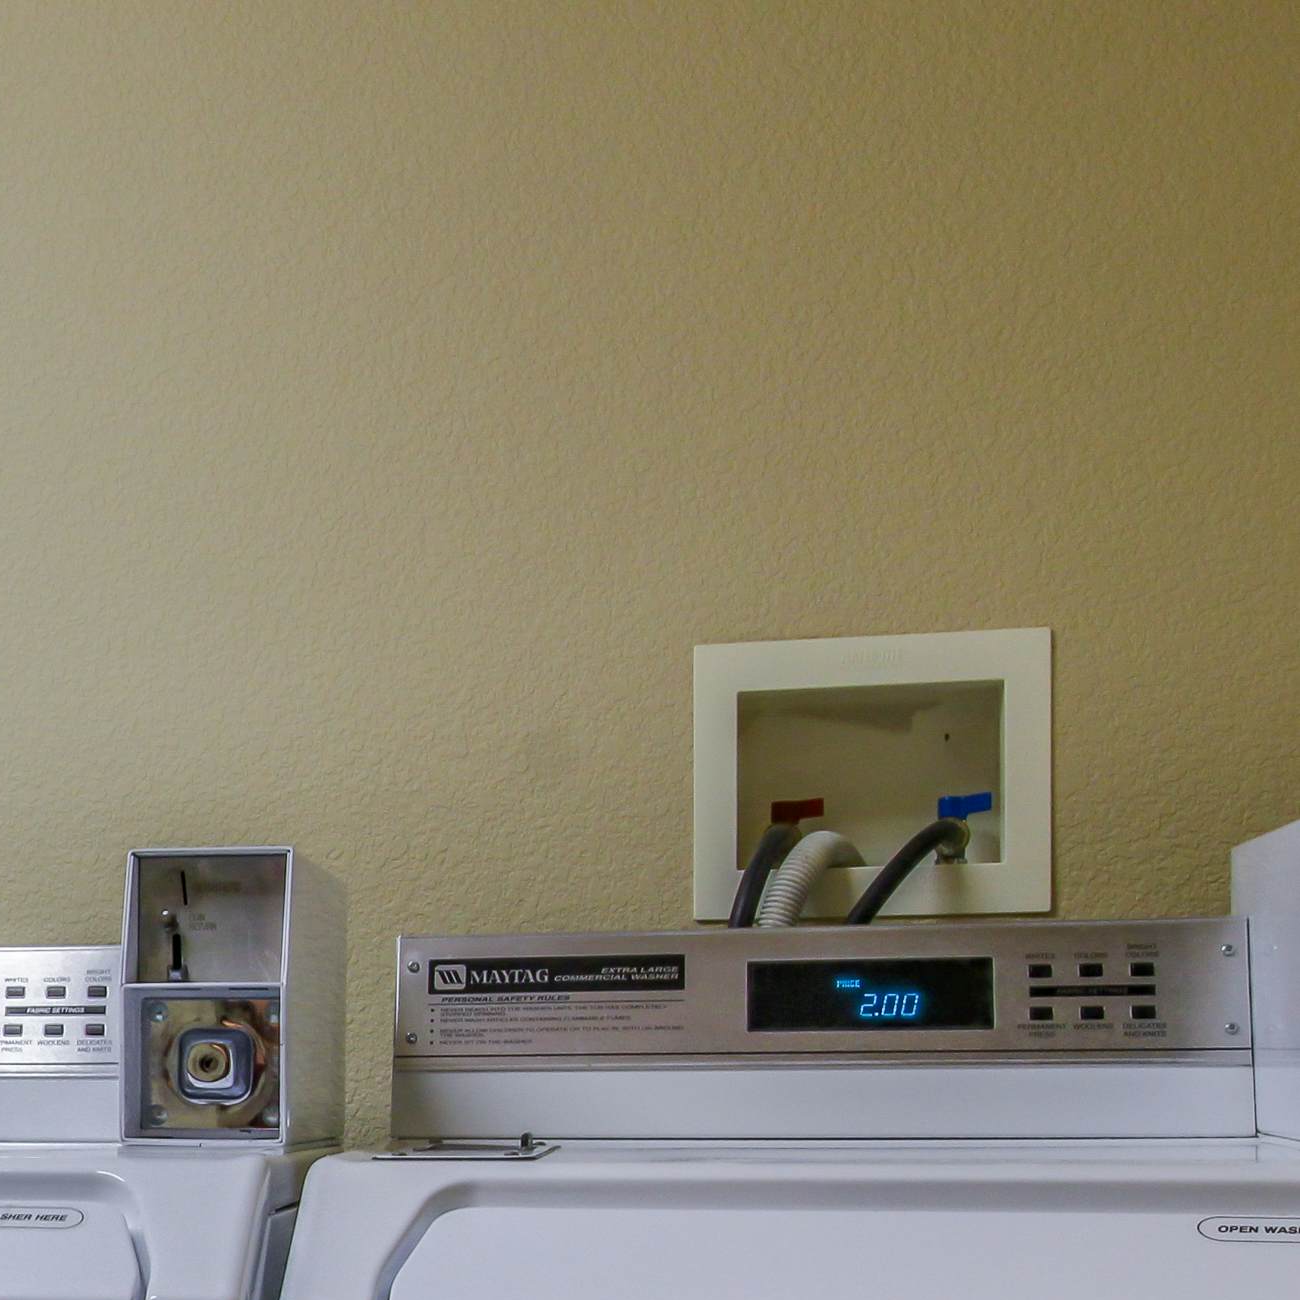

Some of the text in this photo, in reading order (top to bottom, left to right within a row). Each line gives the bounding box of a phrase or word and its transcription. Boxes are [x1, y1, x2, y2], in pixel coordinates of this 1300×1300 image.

[600, 965, 679, 974] EXTRA LARGE
[470, 968, 549, 984] MAYTAG
[553, 972, 679, 982] COMMERCIAL WASHER
[860, 993, 919, 1016] 2.00
[35, 1214, 68, 1222] HERE
[1218, 1225, 1300, 1234] OPEN WAS
